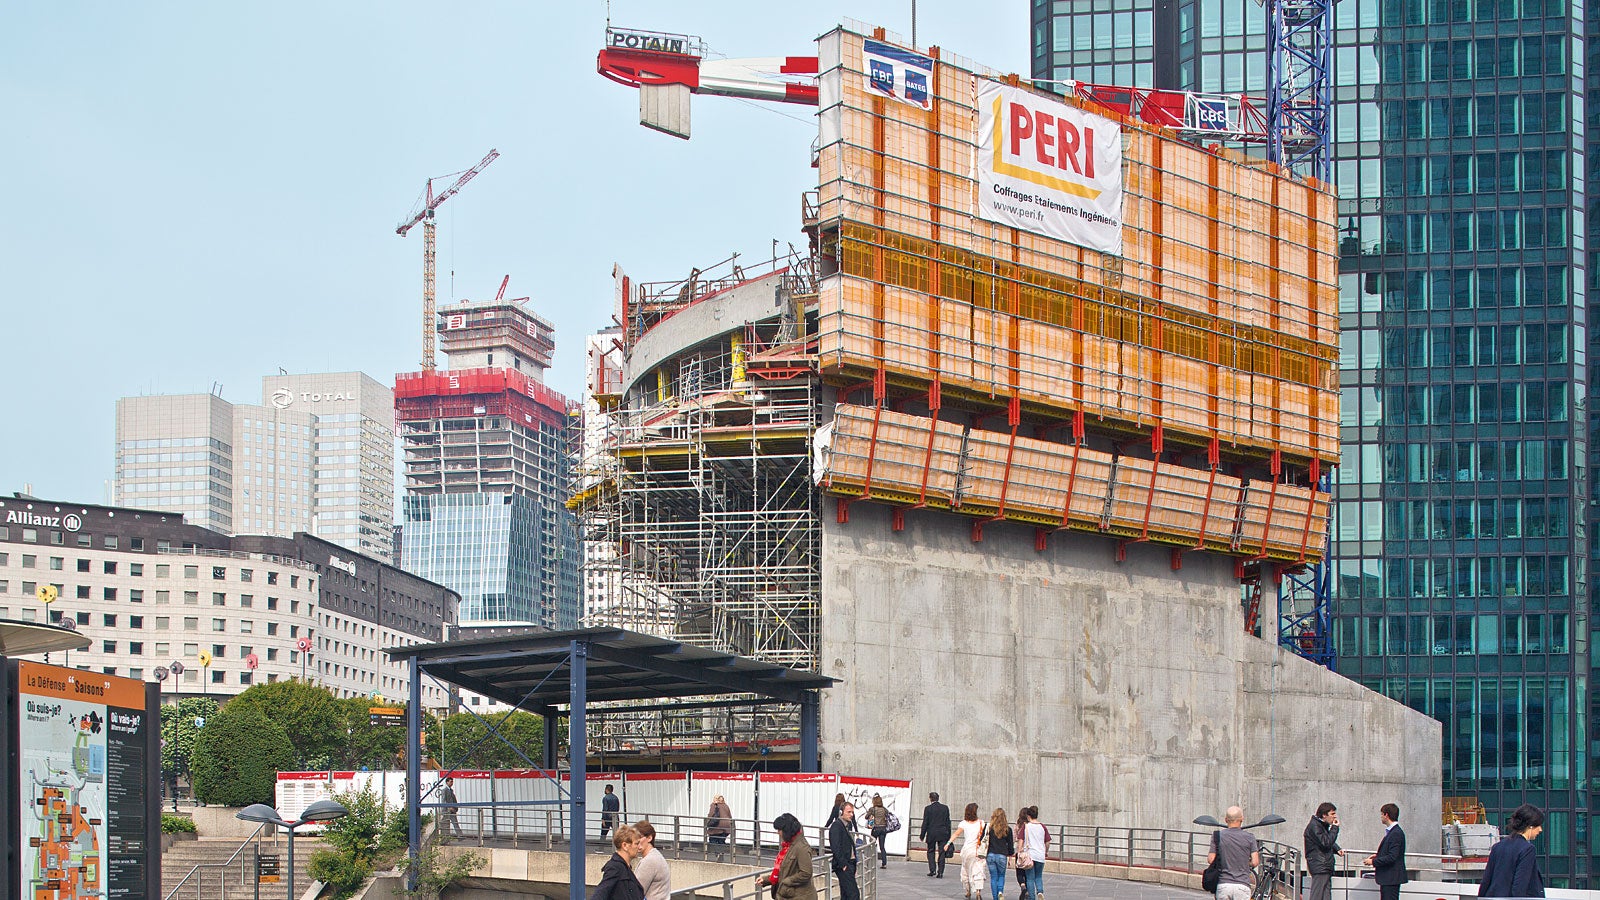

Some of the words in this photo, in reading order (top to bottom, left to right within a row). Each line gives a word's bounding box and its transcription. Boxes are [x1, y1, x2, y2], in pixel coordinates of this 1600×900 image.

[613, 34, 683, 53] POTAIN
[872, 69, 893, 84] CBC
[906, 81, 926, 92] BATEG
[1200, 110, 1224, 122] CBC
[1009, 102, 1095, 179] PERI
[993, 184, 1033, 203] Coffrages
[1035, 195, 1079, 216] Etaiements
[993, 201, 1045, 221] www.peri.fr
[300, 392, 355, 402] TOTAL
[6, 510, 60, 527] Allianz
[27, 674, 36, 687] La
[37, 675, 66, 691] Défense
[27, 700, 36, 712] Où
[37, 703, 62, 717] suis-je?
